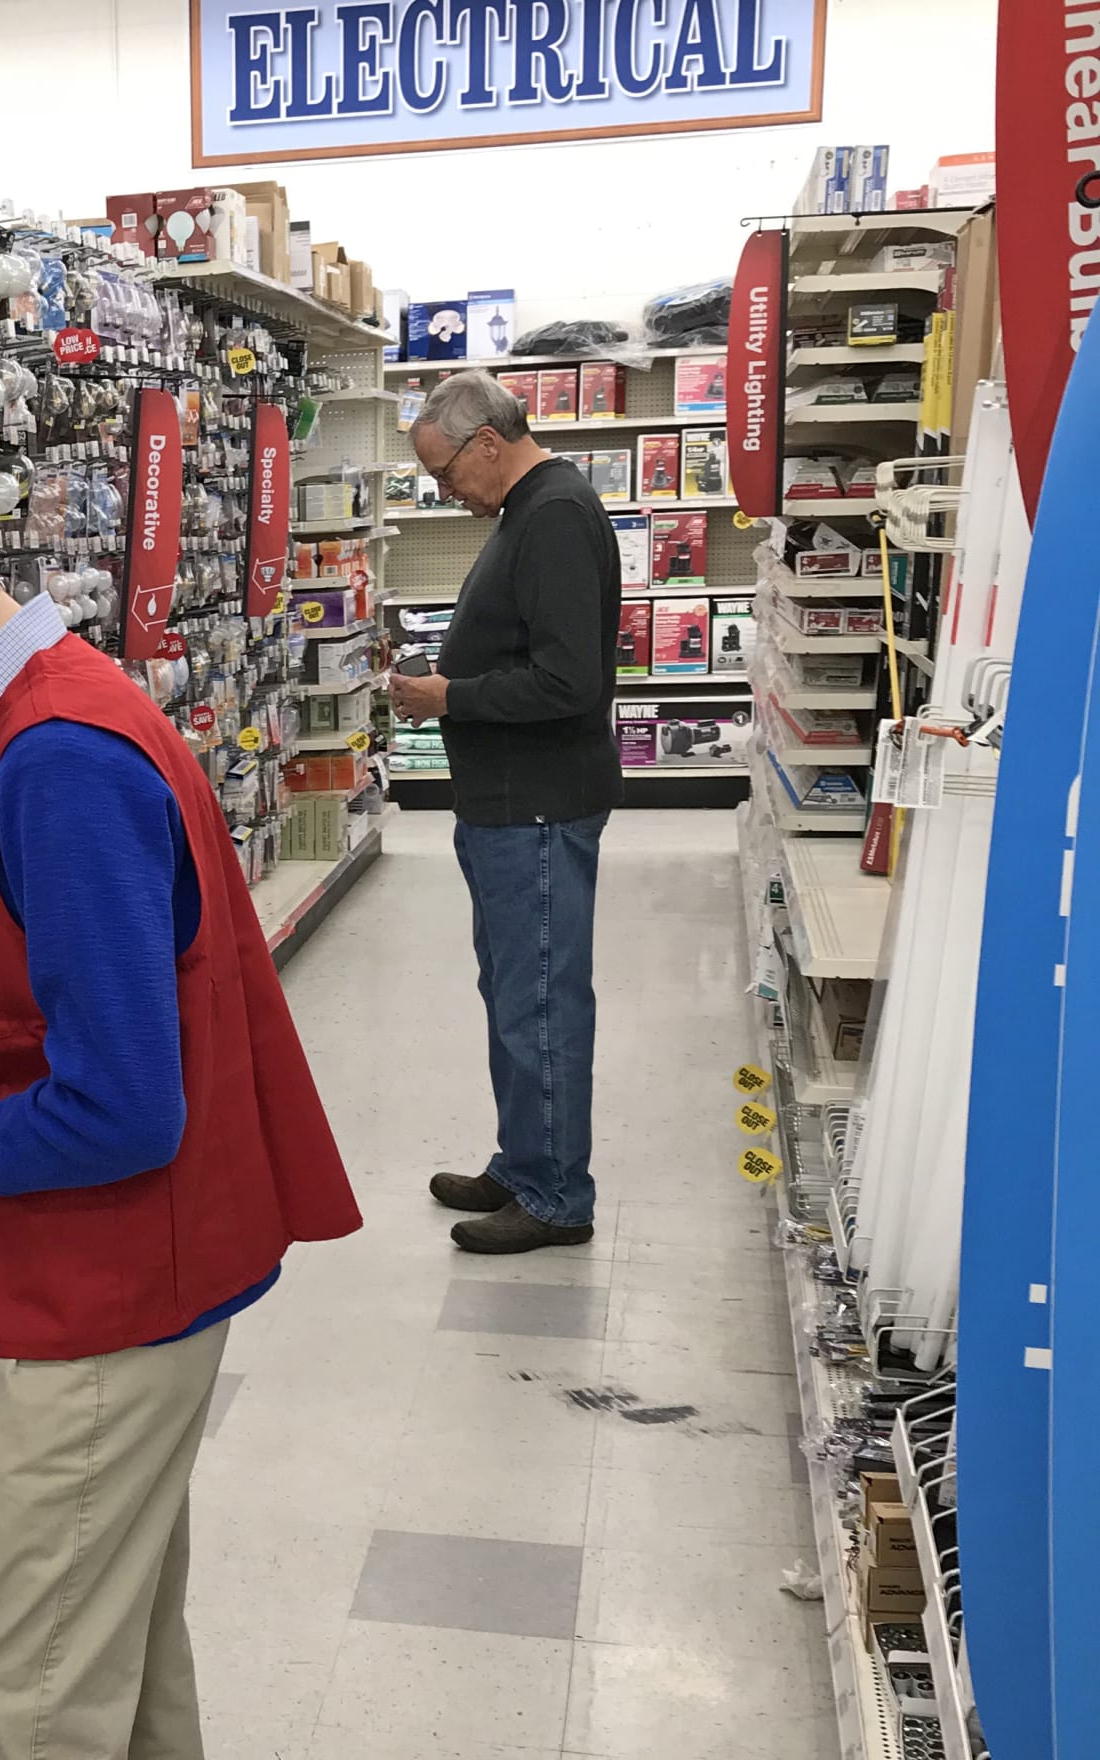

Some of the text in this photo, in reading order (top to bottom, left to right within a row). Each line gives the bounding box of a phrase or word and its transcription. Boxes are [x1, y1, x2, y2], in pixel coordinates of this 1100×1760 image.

[228, 0, 788, 122] ELECTRICAL
[1065, 0, 1100, 188] near
[61, 334, 79, 346] LOW
[60, 343, 84, 356] PRICE
[231, 354, 253, 365] CLOSE
[236, 362, 250, 370] OUT
[744, 286, 769, 452] Utility Lighting
[142, 434, 166, 550] Decorative
[257, 447, 277, 526] Specialty
[716, 602, 750, 614] WAYNE
[618, 704, 660, 719] WAYNE
[193, 715, 214, 726] SAVE
[738, 1066, 764, 1088] CLOSE
[738, 1076, 756, 1091] OUT
[741, 1106, 770, 1127] CLOSE
[741, 1116, 760, 1130] OUT
[744, 1150, 774, 1174] CLOSE
[744, 1162, 762, 1178] OUT
